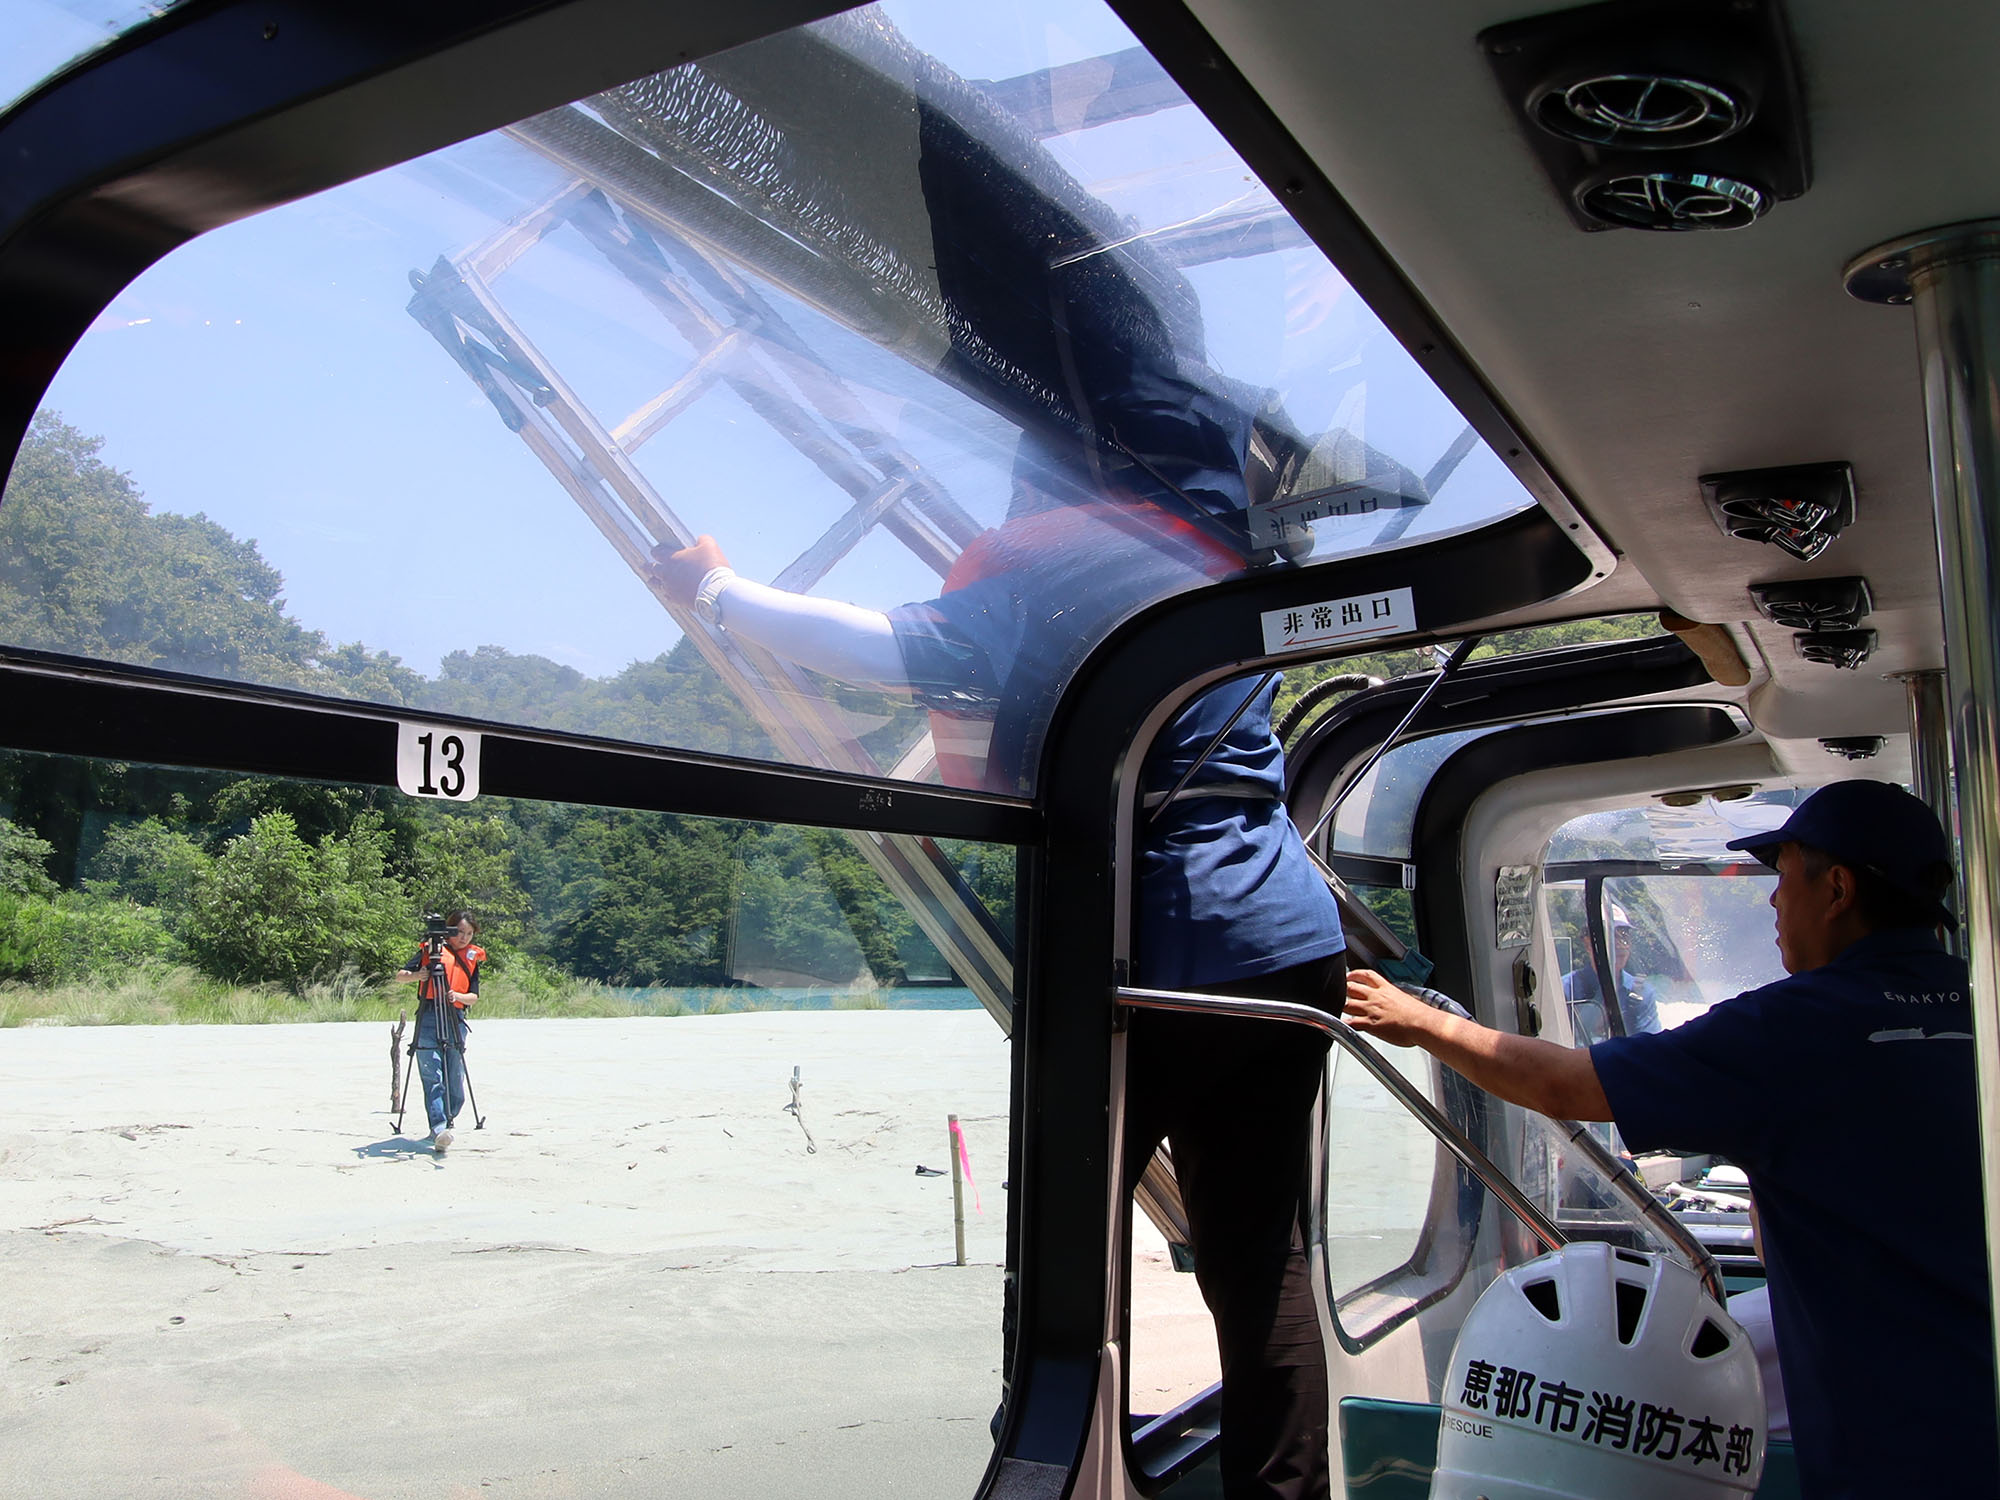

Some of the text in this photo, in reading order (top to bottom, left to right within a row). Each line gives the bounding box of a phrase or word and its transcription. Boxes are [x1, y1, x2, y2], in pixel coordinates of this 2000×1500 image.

[1283, 597, 1391, 636] 非常出口
[418, 732, 465, 797] 13
[1884, 991, 1960, 1004] ENAKYO
[1445, 1415, 1493, 1438] RESCUE
[1460, 1359, 1753, 1476] 恵那市消防本部
